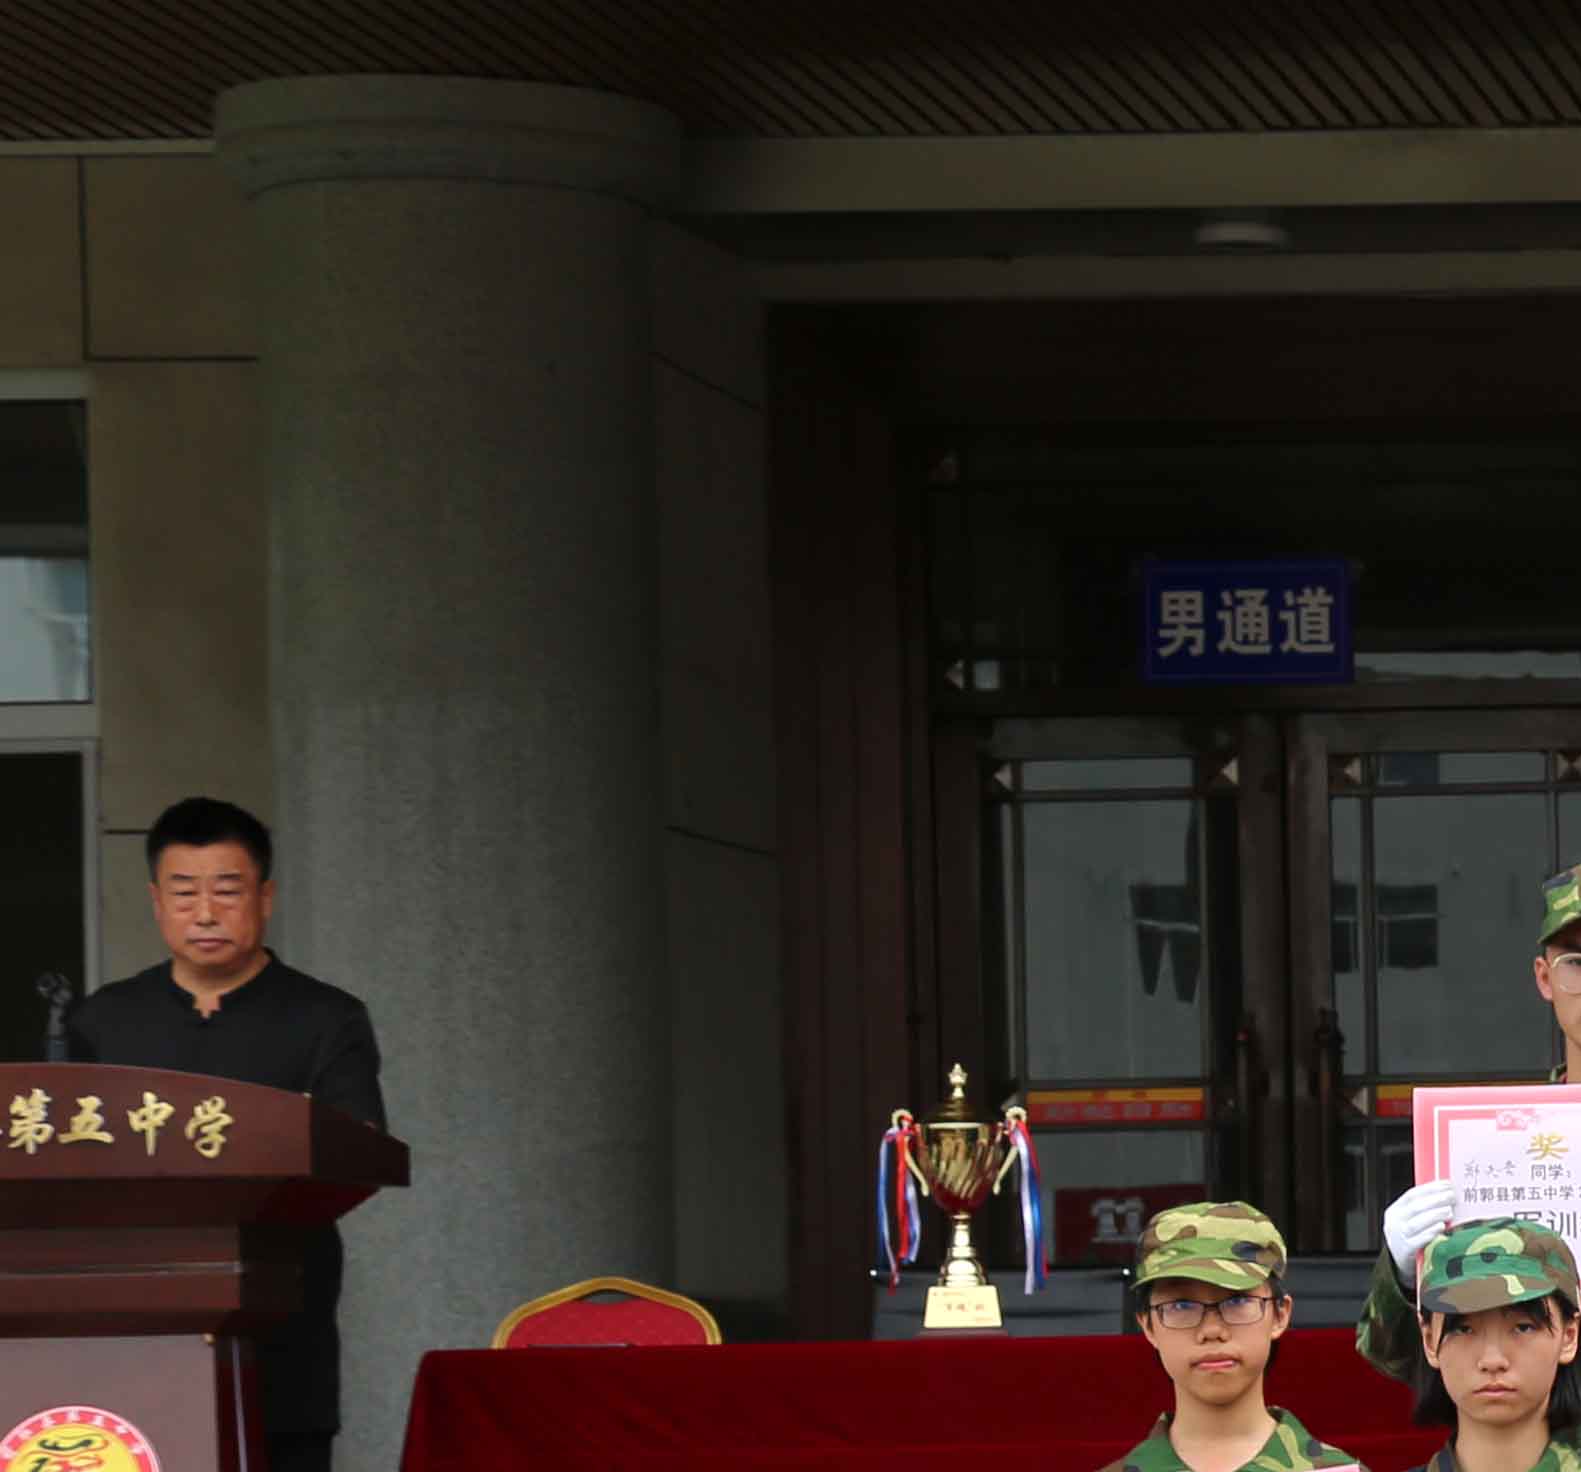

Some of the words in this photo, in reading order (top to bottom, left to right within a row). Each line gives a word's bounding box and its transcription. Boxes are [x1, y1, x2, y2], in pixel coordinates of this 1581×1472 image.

[1157, 586, 1335, 659] 男通道
[0, 1088, 235, 1159] 第五中学
